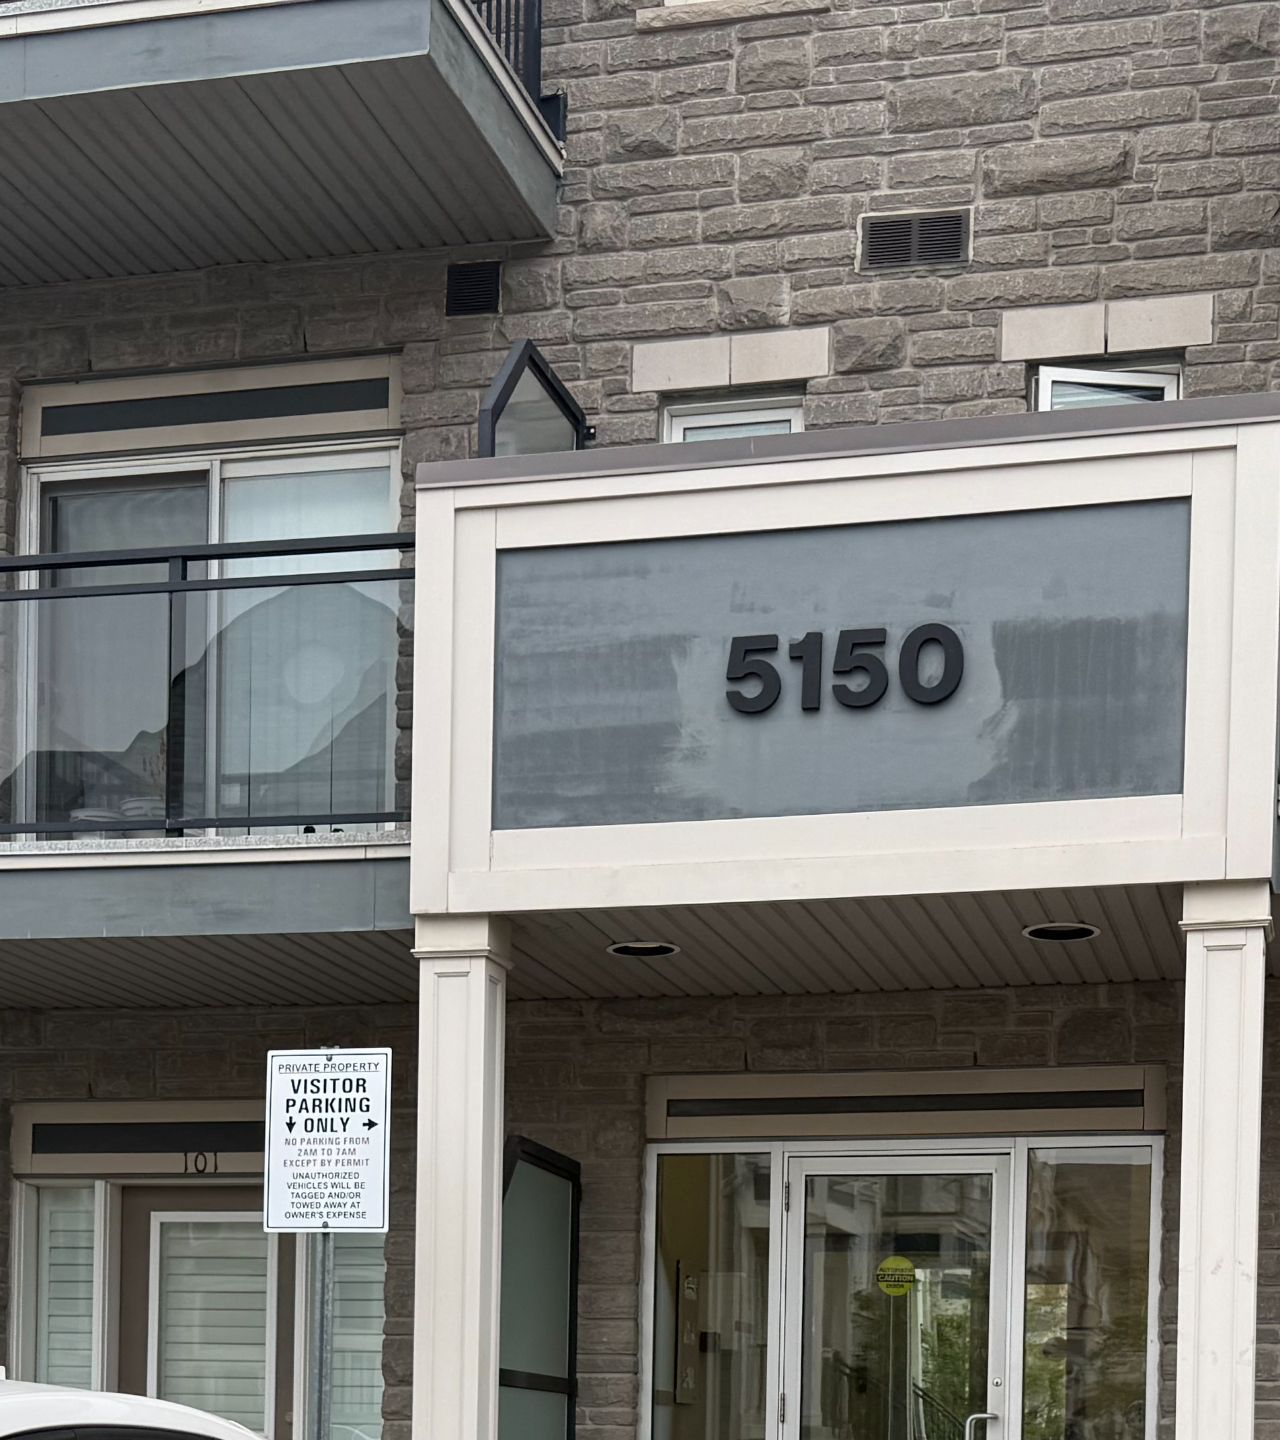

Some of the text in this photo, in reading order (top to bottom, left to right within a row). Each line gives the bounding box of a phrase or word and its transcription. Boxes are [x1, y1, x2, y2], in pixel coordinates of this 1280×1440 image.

[725, 622, 965, 715] 5150
[278, 1062, 380, 1073] PRIVATE PROPERTY
[290, 1078, 367, 1094] VISITOR
[285, 1097, 370, 1114] PARKING
[304, 1117, 350, 1133] ONLY
[284, 1137, 370, 1146] NO PARKING FROM
[297, 1147, 357, 1157] 2AM TO 7AM
[183, 1151, 219, 1174] 101
[283, 1158, 370, 1167] EXCEPT BY PERMIT
[292, 1171, 360, 1180] UNAUTHORIZED
[286, 1181, 366, 1190] VEHICLES WILL BE
[290, 1191, 361, 1200] TAGGED AND/OR
[290, 1201, 361, 1210] TOWED AWAY AT
[284, 1211, 367, 1220] OWNER'S EXPENSE
